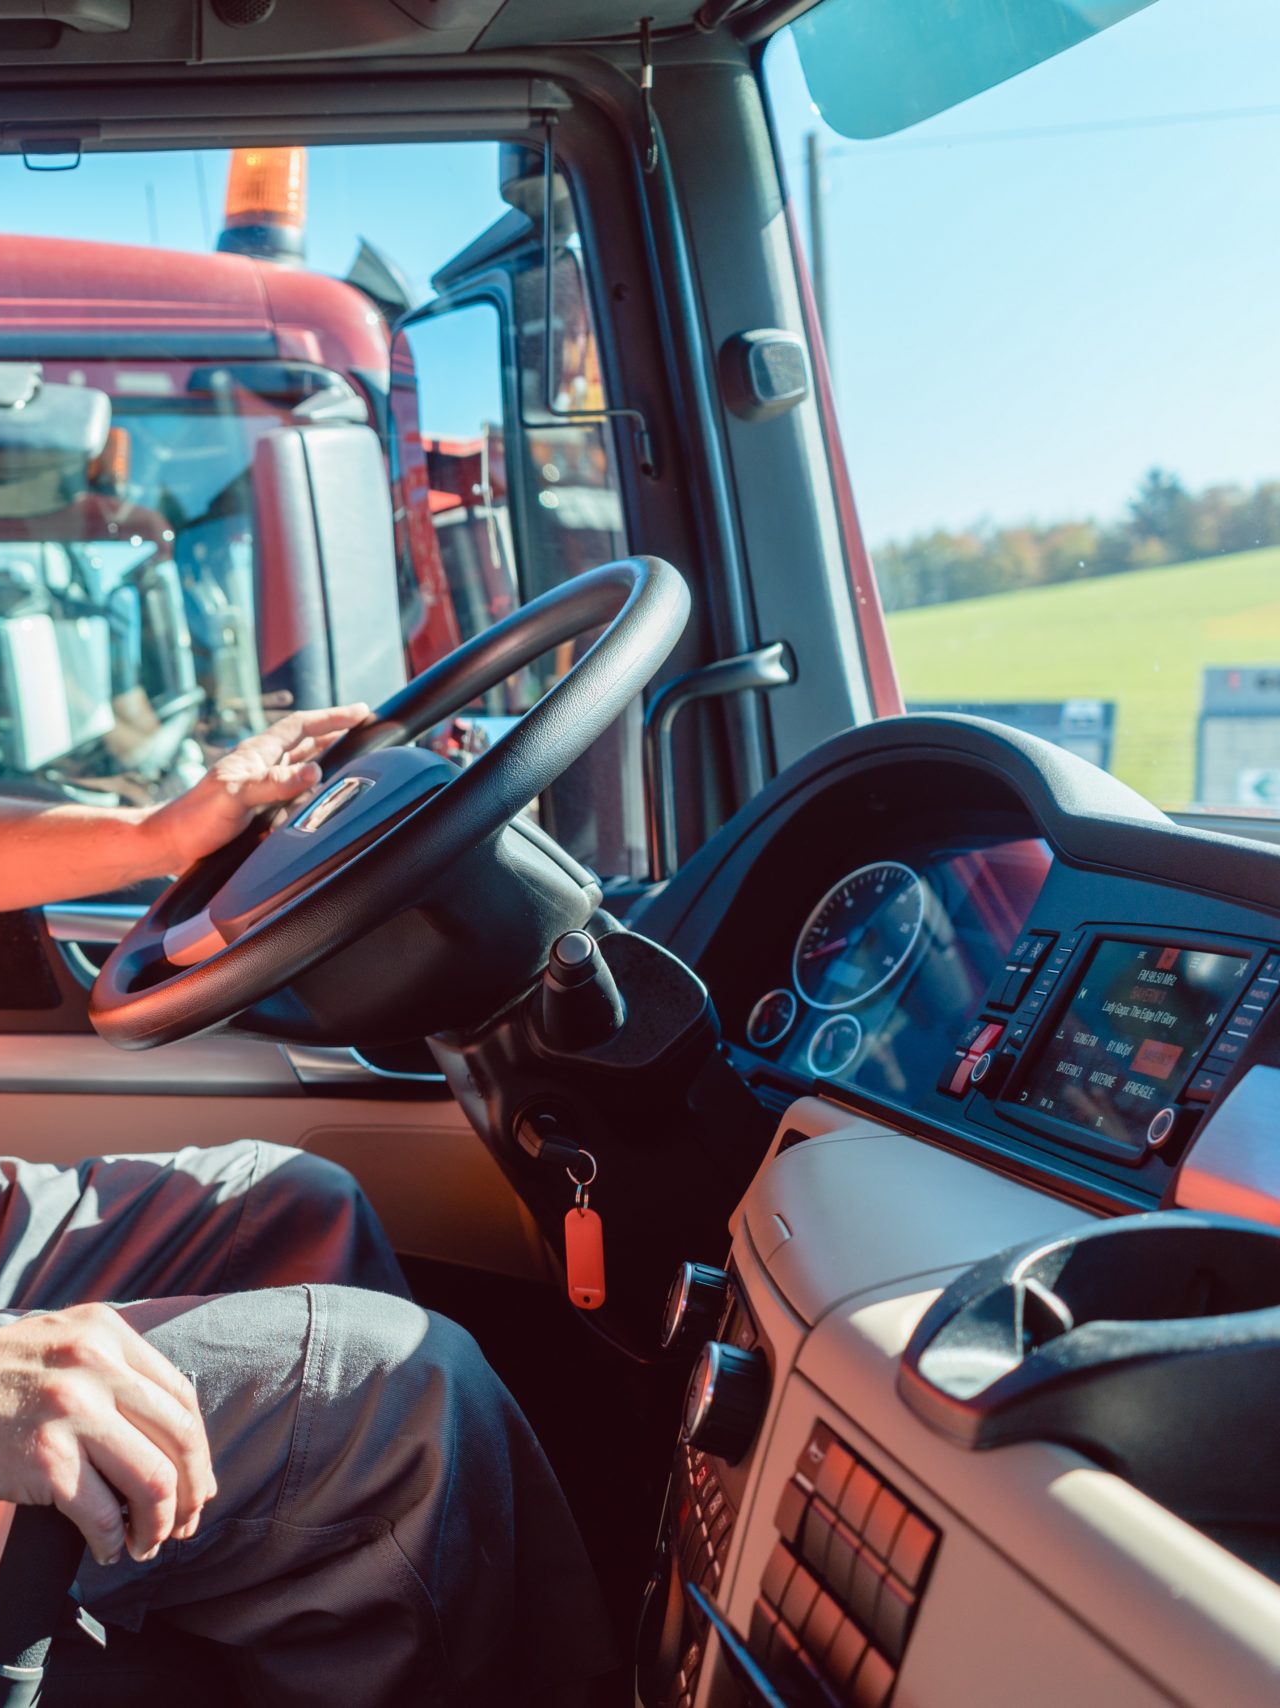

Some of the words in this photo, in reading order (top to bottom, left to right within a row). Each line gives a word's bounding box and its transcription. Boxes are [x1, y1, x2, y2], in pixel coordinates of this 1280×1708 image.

[1138, 969, 1149, 981] FM
[1102, 1000, 1117, 1016] Lady
[1130, 1005, 1142, 1018] The
[1140, 1008, 1155, 1023] Edge
[1153, 1010, 1164, 1022] Of
[1161, 1012, 1178, 1028] Glory
[1056, 1061, 1081, 1077] BAYERN
[1089, 1071, 1118, 1088] ANTENNE
